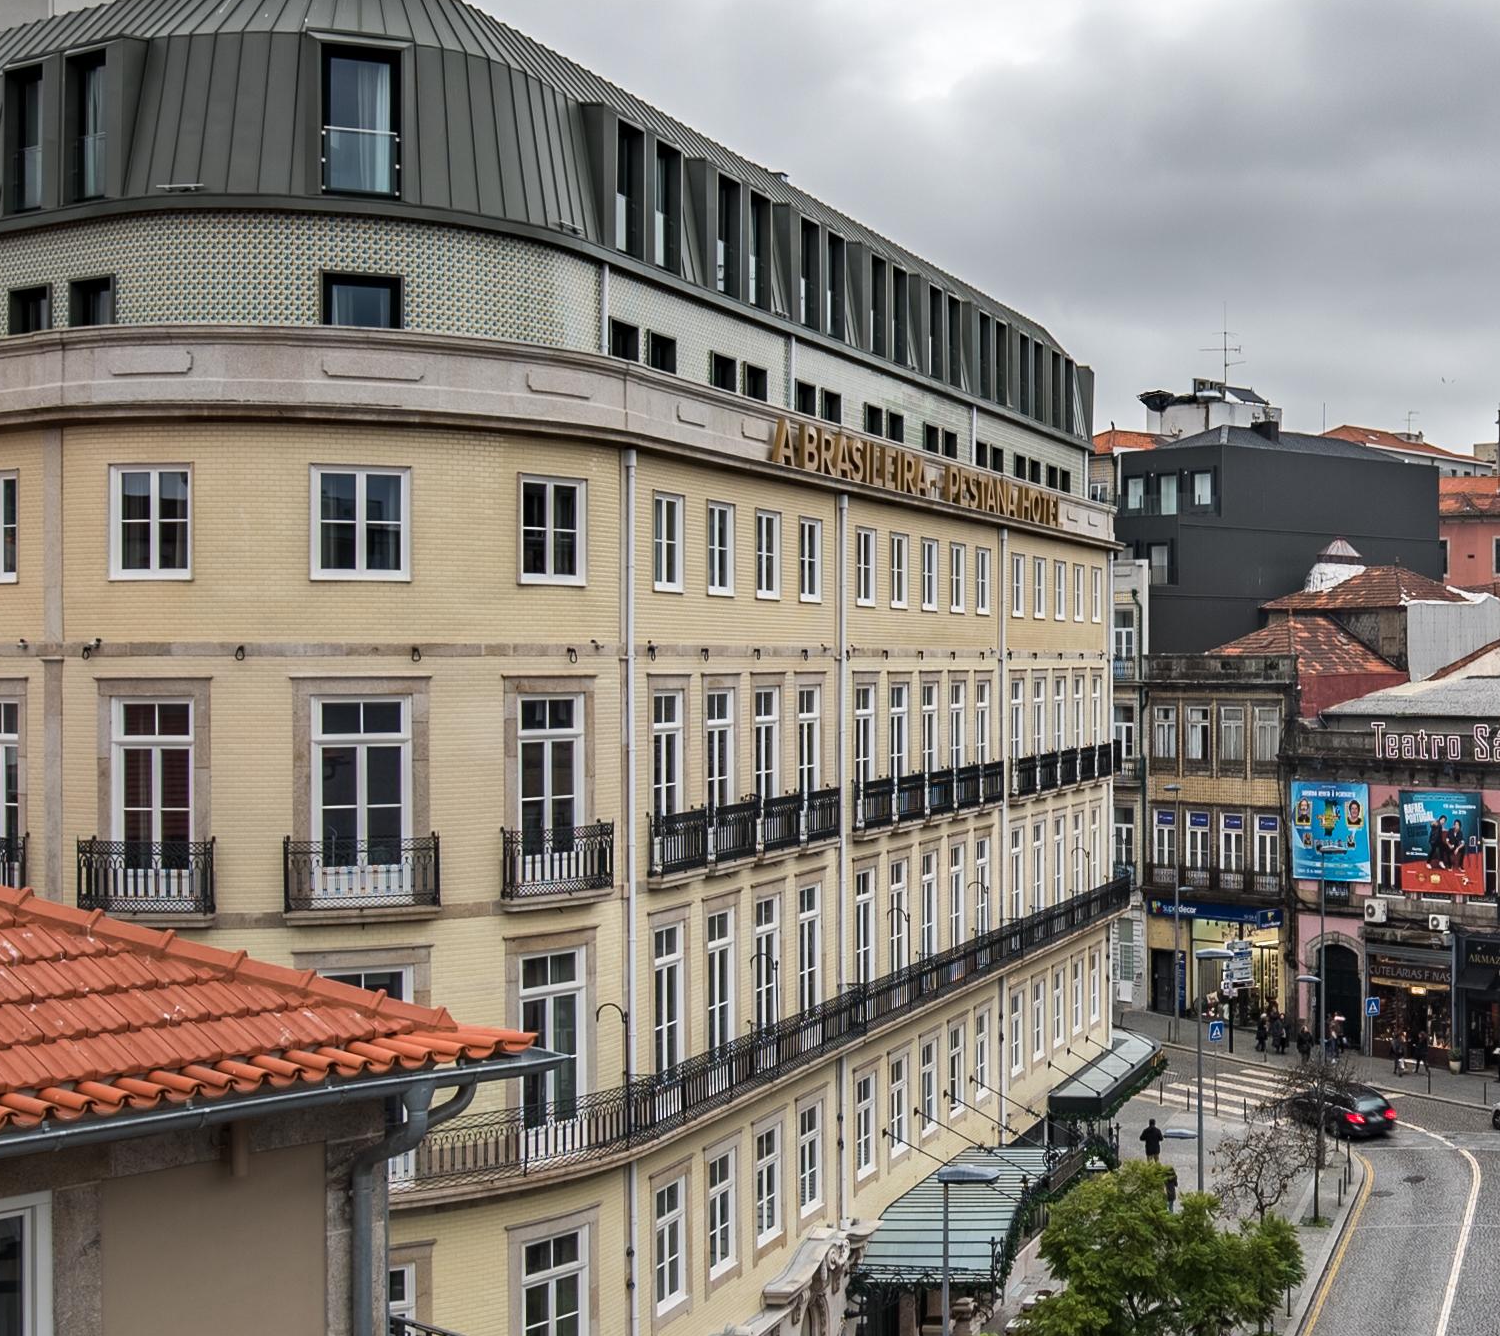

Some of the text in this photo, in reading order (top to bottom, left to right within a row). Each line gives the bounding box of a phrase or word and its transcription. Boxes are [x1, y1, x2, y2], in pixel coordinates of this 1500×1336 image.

[771, 417, 1064, 528] A BRASILEIRA PESTANA HOTEL
[1371, 722, 1461, 761] Teatro
[1369, 965, 1422, 979] CUTELARIAS
